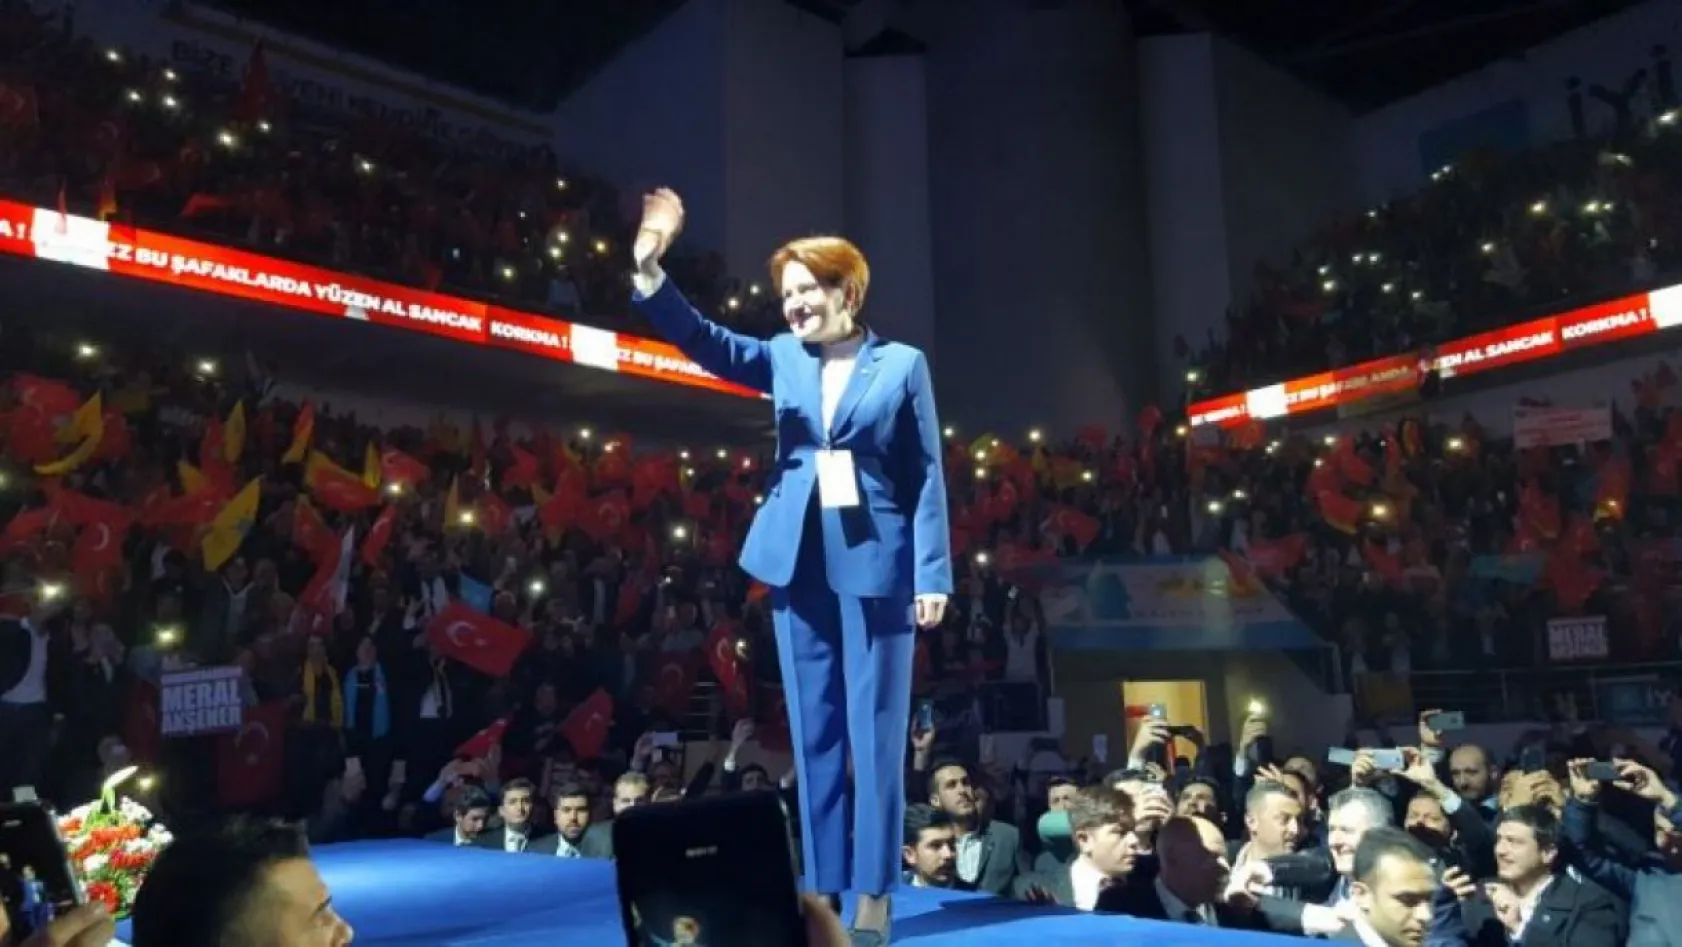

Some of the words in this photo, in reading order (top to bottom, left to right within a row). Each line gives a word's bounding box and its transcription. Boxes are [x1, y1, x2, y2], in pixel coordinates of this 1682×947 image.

[136, 247, 168, 267] BU
[171, 254, 312, 297] ŞAFAKLARDA
[382, 298, 407, 317] AL
[408, 304, 482, 333] SANCAK
[162, 678, 242, 713] MERAL
